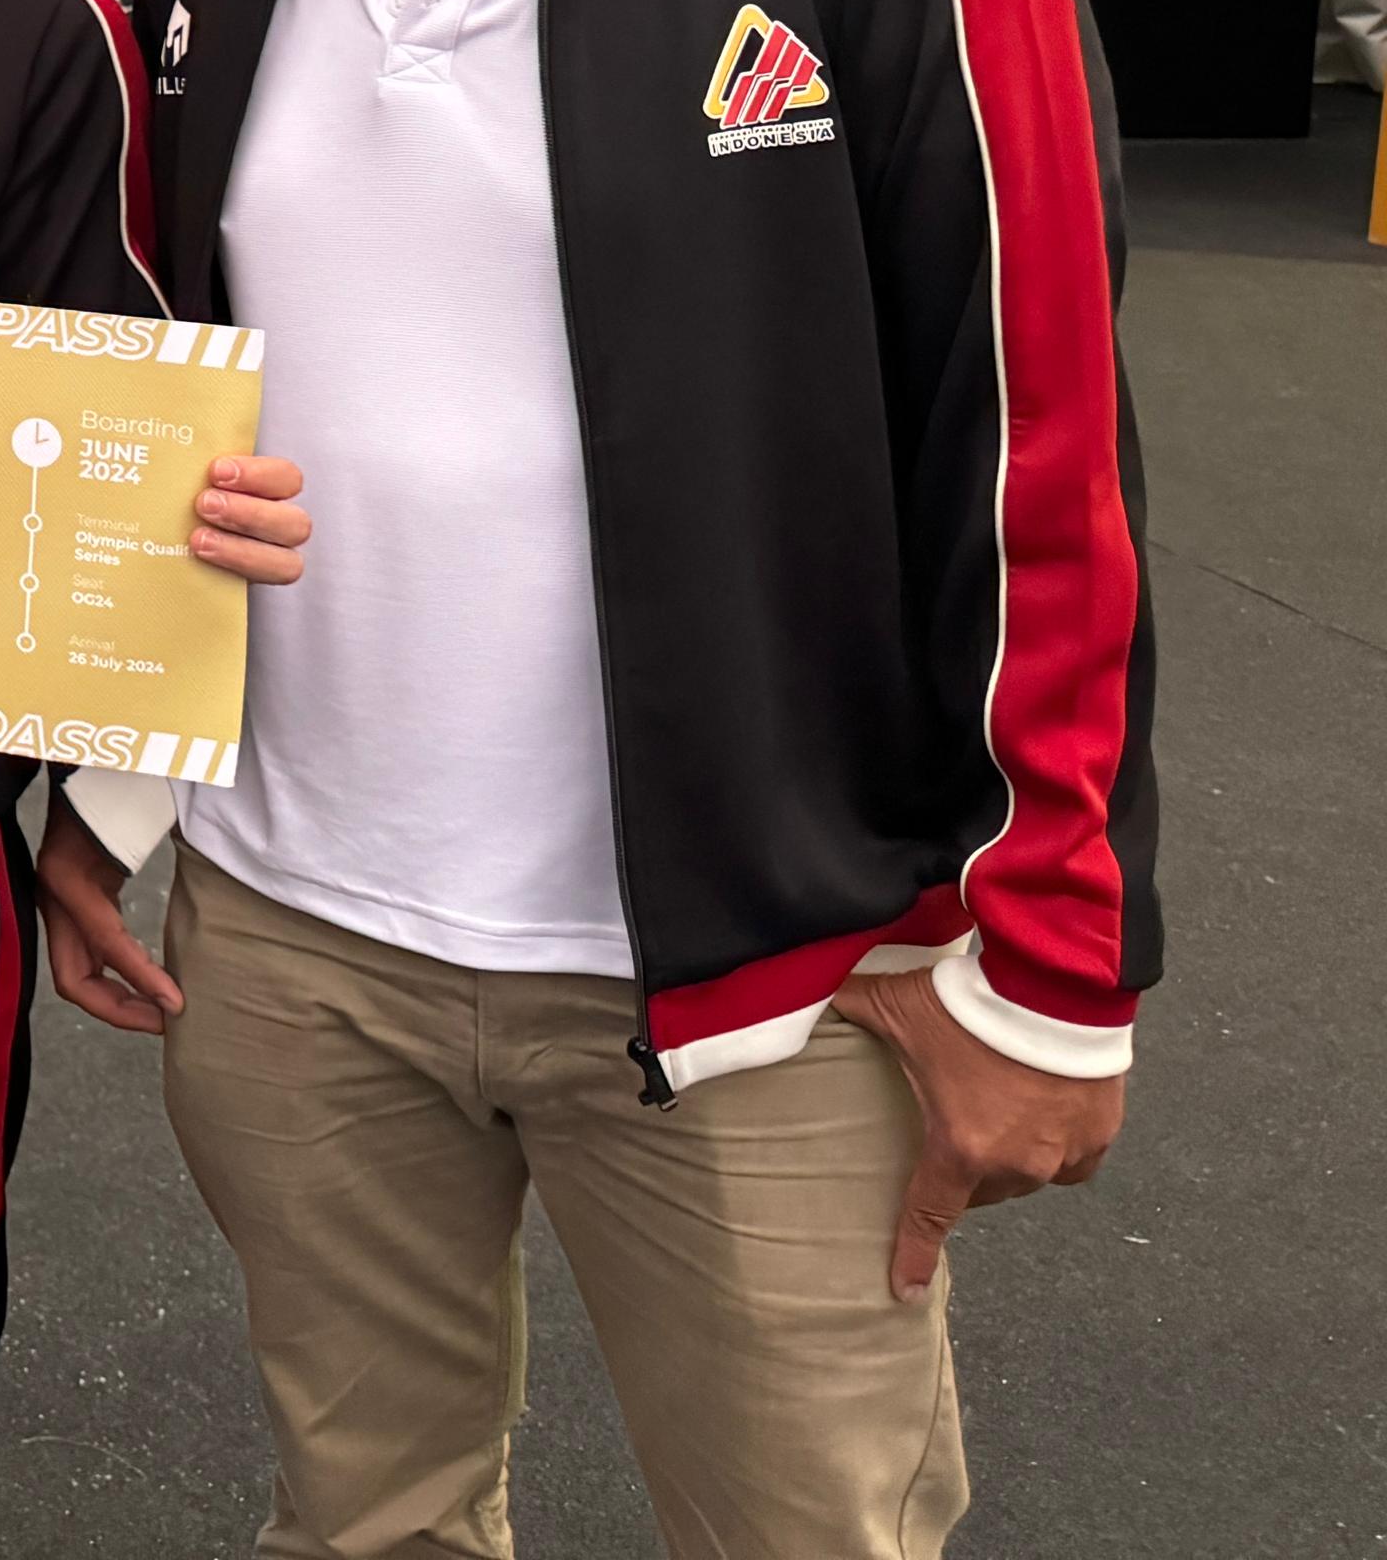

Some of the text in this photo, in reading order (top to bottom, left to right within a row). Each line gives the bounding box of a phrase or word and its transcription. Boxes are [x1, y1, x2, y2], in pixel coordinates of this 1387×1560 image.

[156, 76, 186, 95] ILL
[712, 128, 832, 154] INDONESIA
[80, 409, 194, 445] Boarding
[79, 439, 150, 464] JUNE
[78, 460, 141, 485] 2024
[75, 530, 192, 558] Olympic Qualif
[74, 547, 121, 567] Series
[71, 591, 115, 609] OG24
[68, 651, 165, 675] 26 July 2024
